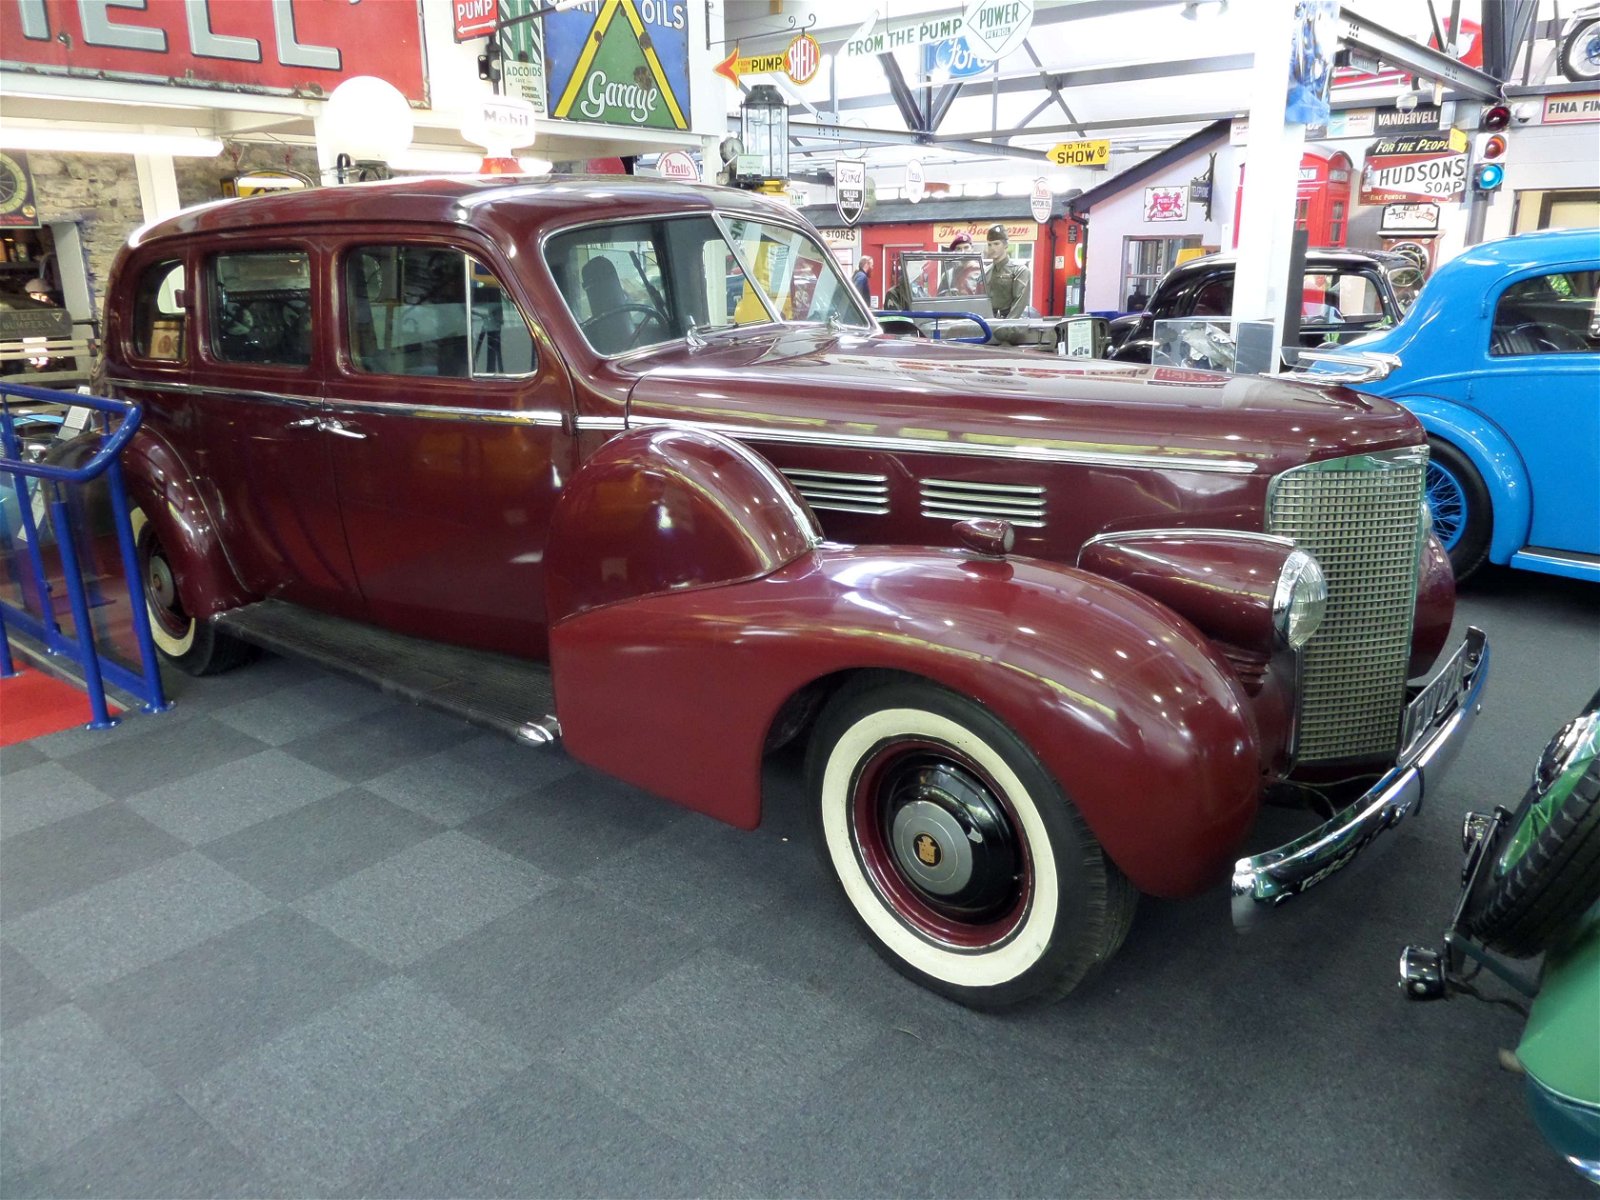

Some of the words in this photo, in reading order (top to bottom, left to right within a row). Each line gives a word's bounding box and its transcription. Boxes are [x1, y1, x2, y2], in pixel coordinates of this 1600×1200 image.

[457, 0, 493, 21] PUMP
[641, 0, 685, 29] OILS
[979, 2, 1019, 29] POWER
[847, 34, 884, 56] FROM
[887, 28, 915, 48] THE
[919, 18, 962, 42] PUMP
[751, 57, 782, 72] PUMP
[788, 37, 818, 80] SHELL
[506, 66, 542, 76] ADCOIDS
[581, 71, 657, 122] Garage
[1548, 102, 1577, 113] FINA
[484, 110, 528, 126] Mobil
[1378, 111, 1438, 126] VANDERVELL
[1376, 142, 1396, 153] FOR
[1396, 143, 1415, 152] THE
[1416, 139, 1450, 151] PEOPL
[1057, 150, 1095, 164] SHOW
[839, 169, 861, 183] Ford
[1379, 157, 1466, 186] HUDSON'S
[1424, 181, 1463, 194] SOAP
[826, 229, 855, 241] STORES
